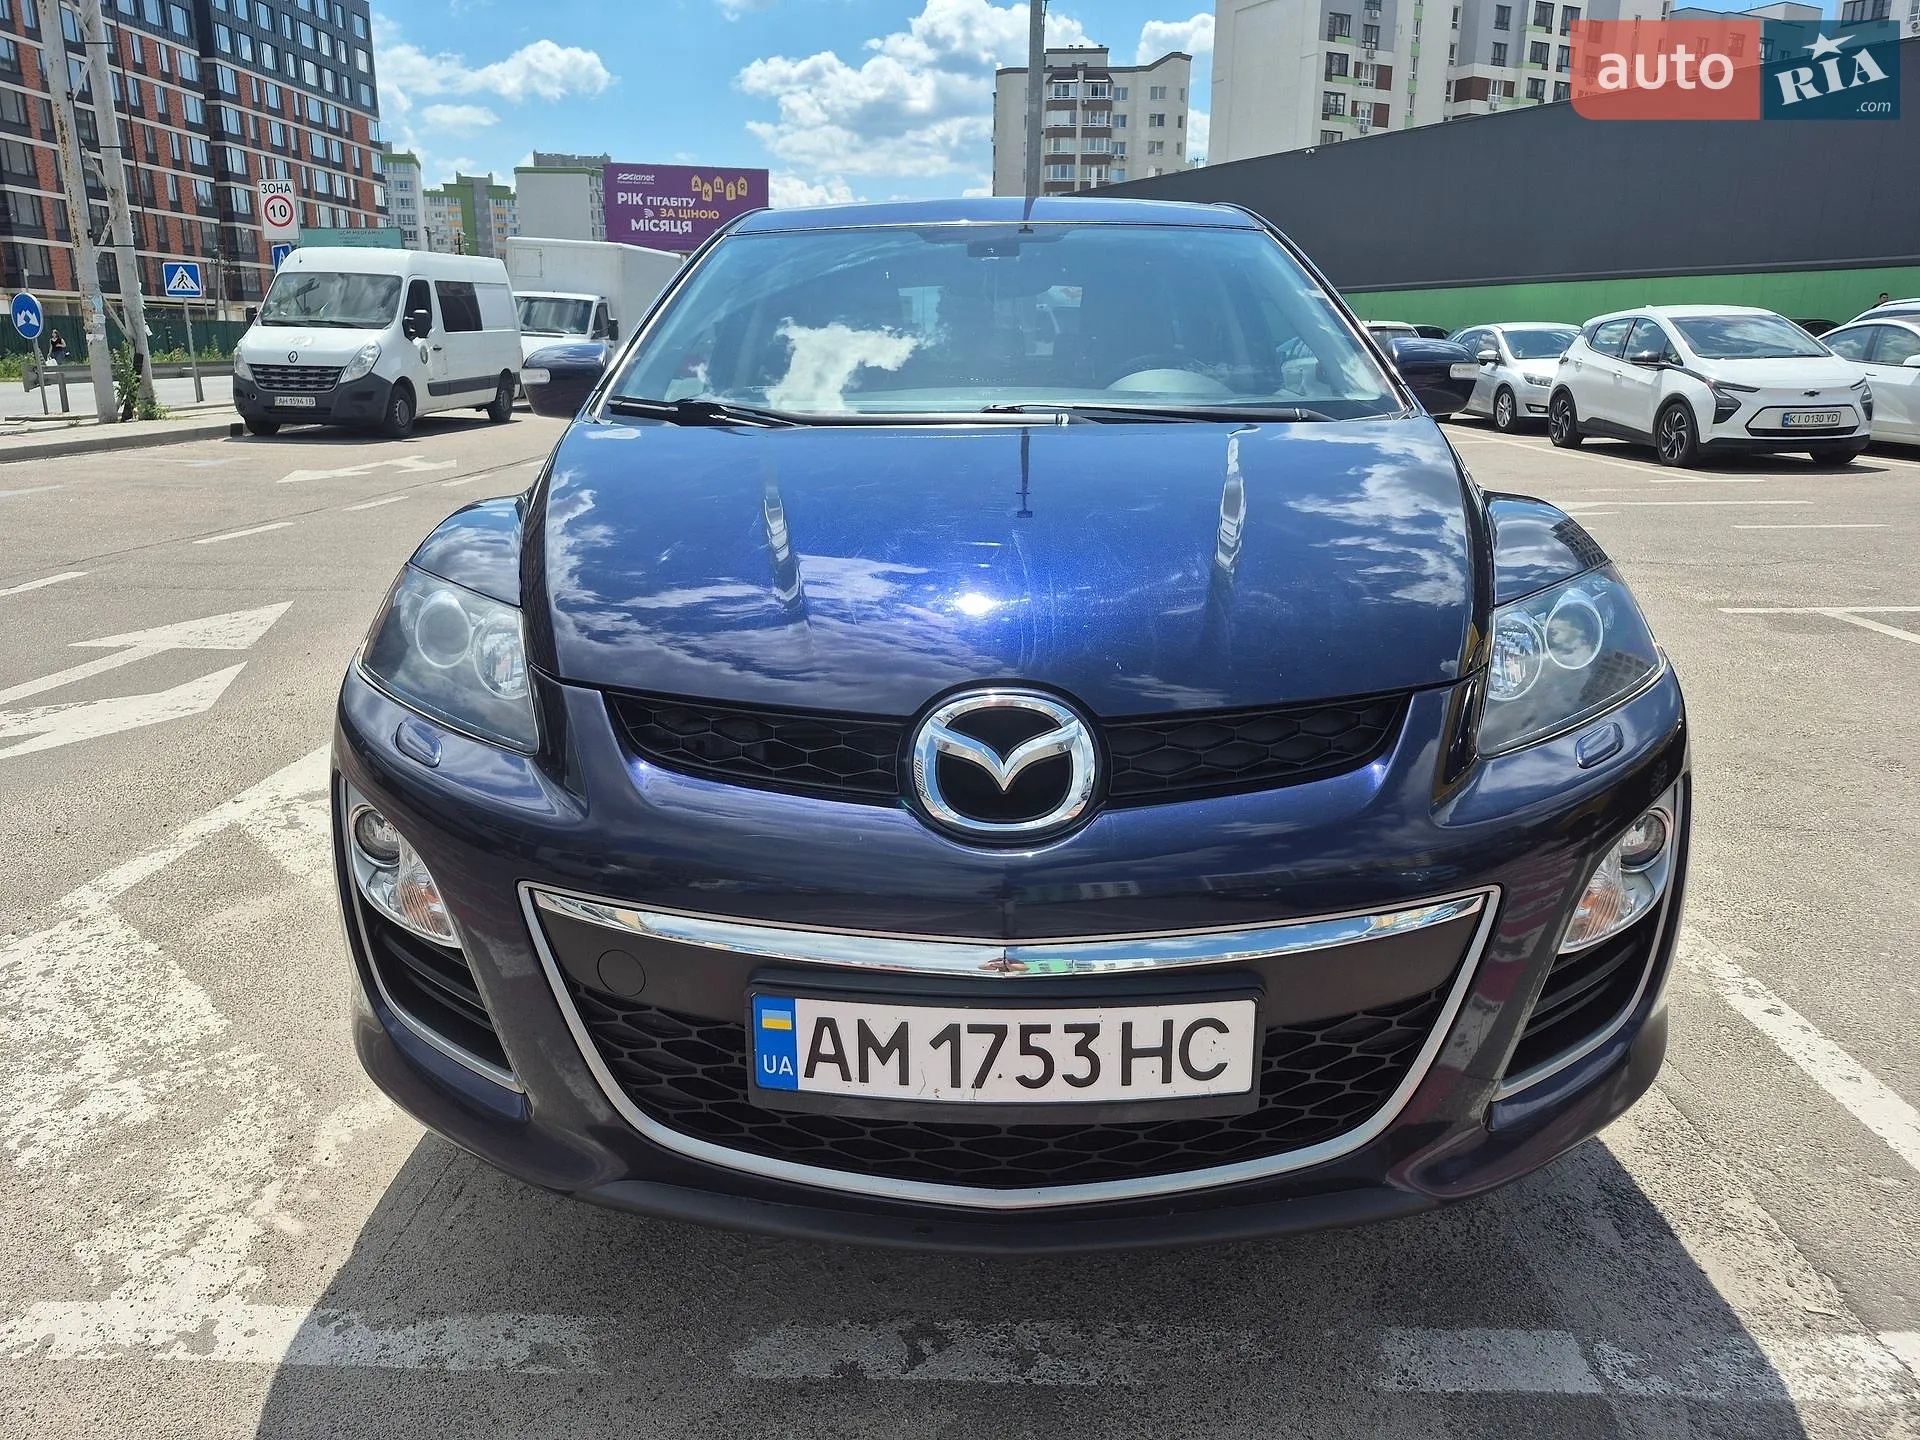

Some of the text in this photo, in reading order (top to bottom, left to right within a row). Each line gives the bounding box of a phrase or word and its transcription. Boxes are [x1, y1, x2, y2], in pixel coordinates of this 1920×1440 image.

[261, 183, 292, 194] ЗОНА
[693, 180, 747, 198] АКЦІЯ
[617, 192, 696, 208] РІК ГІГАБІТУ
[270, 204, 287, 218] 10
[660, 208, 720, 220] ЗА ЦІНОЮ
[631, 218, 692, 235] МІСЯЦЯ
[1804, 414, 1825, 424] 0130
[1826, 414, 1838, 422] YD
[803, 1016, 1230, 1089] AM 1753 HC
[763, 1054, 794, 1076] UA
